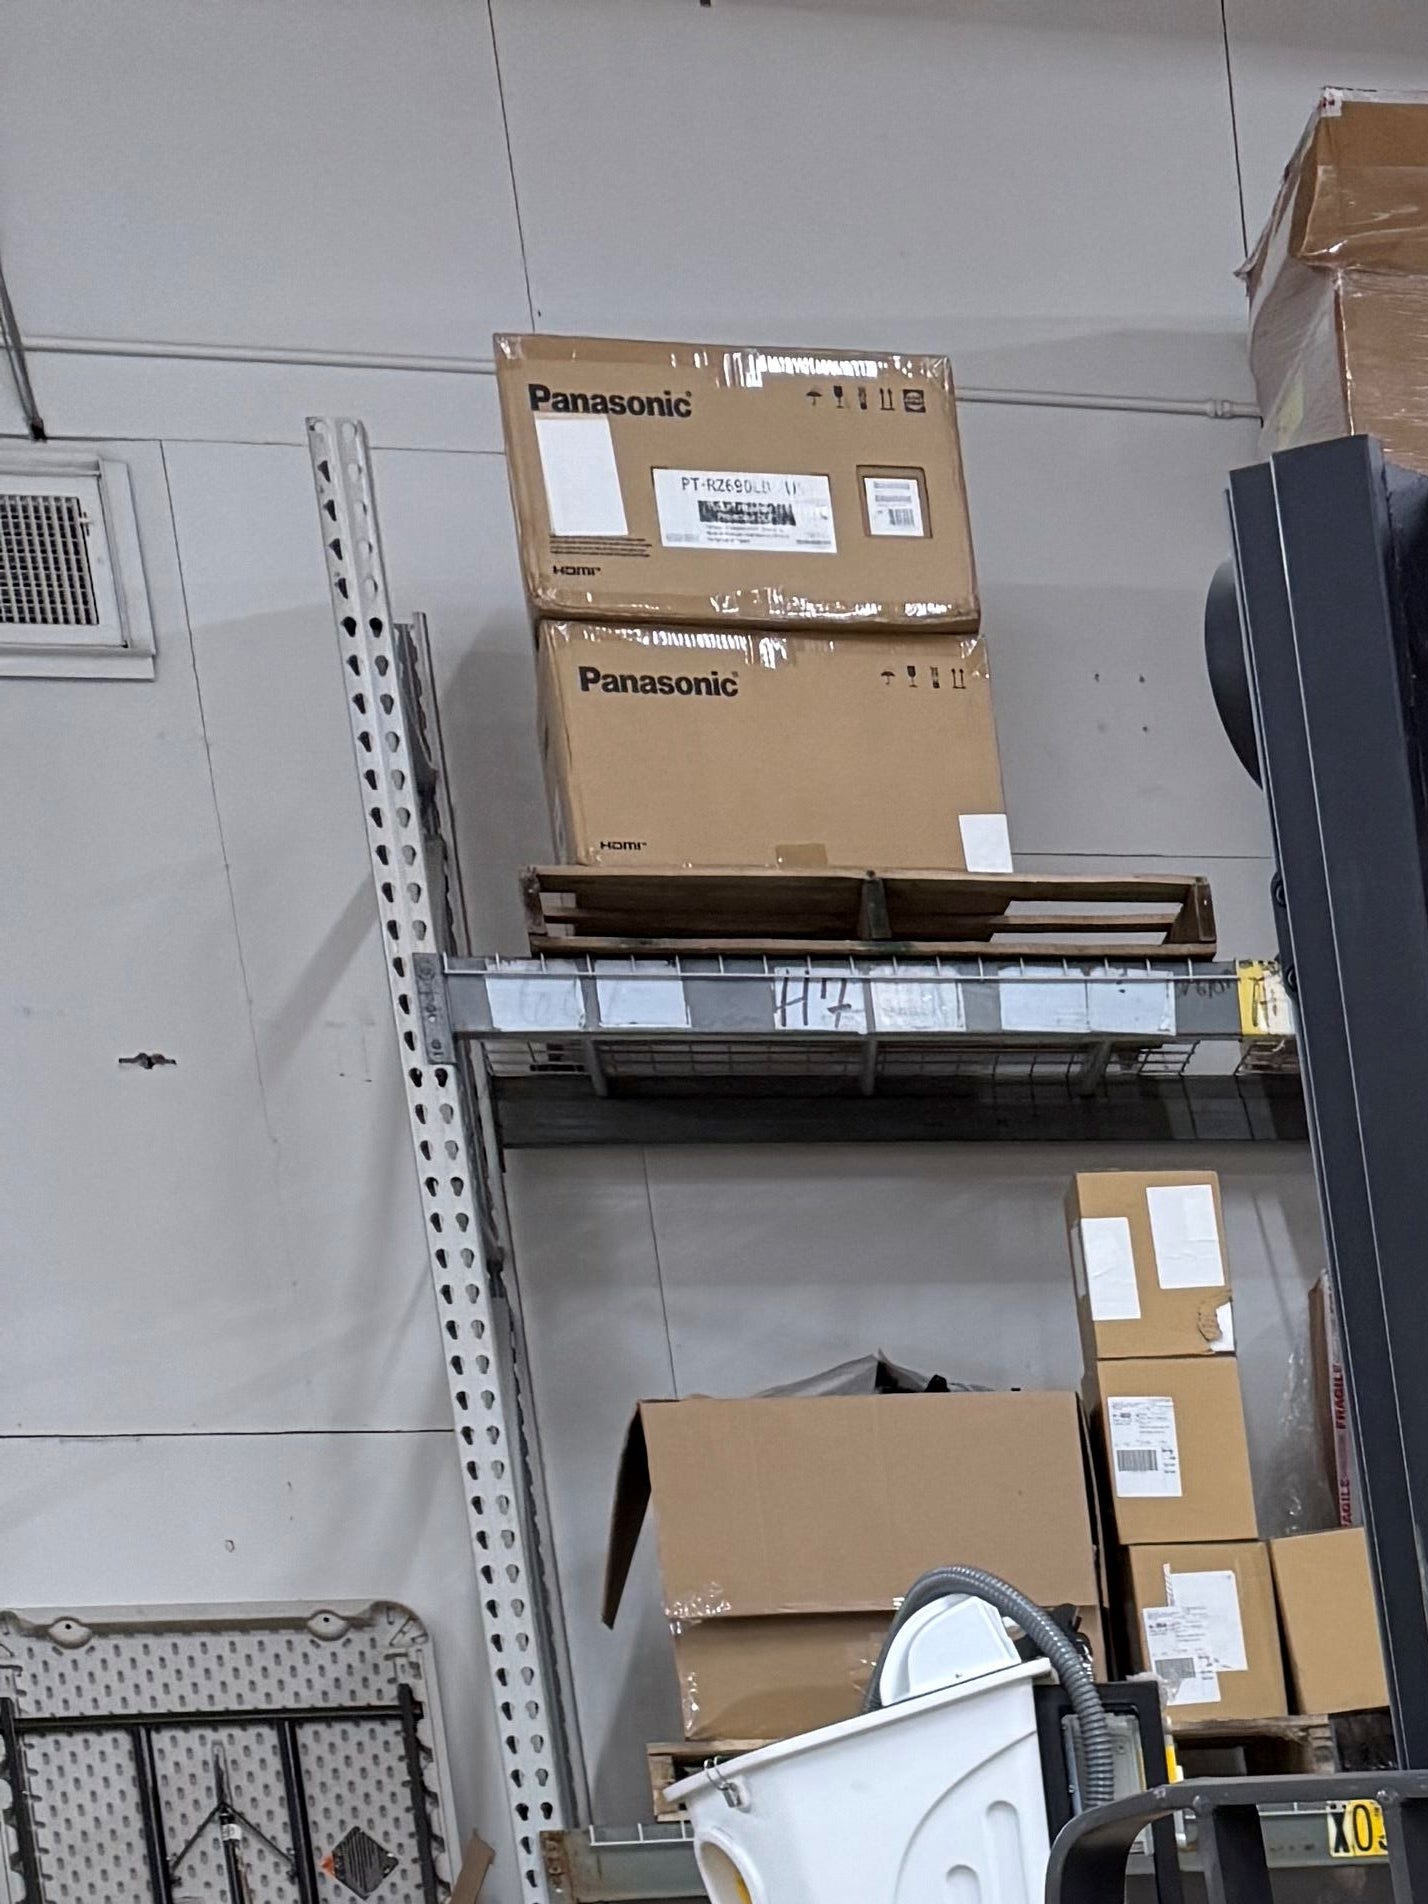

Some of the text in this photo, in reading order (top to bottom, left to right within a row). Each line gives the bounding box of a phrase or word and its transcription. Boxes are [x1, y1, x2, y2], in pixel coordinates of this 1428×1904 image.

[528, 383, 691, 418] Panasonic
[578, 666, 738, 697] Panasonic
[1339, 1479, 1353, 1527] AGILE
